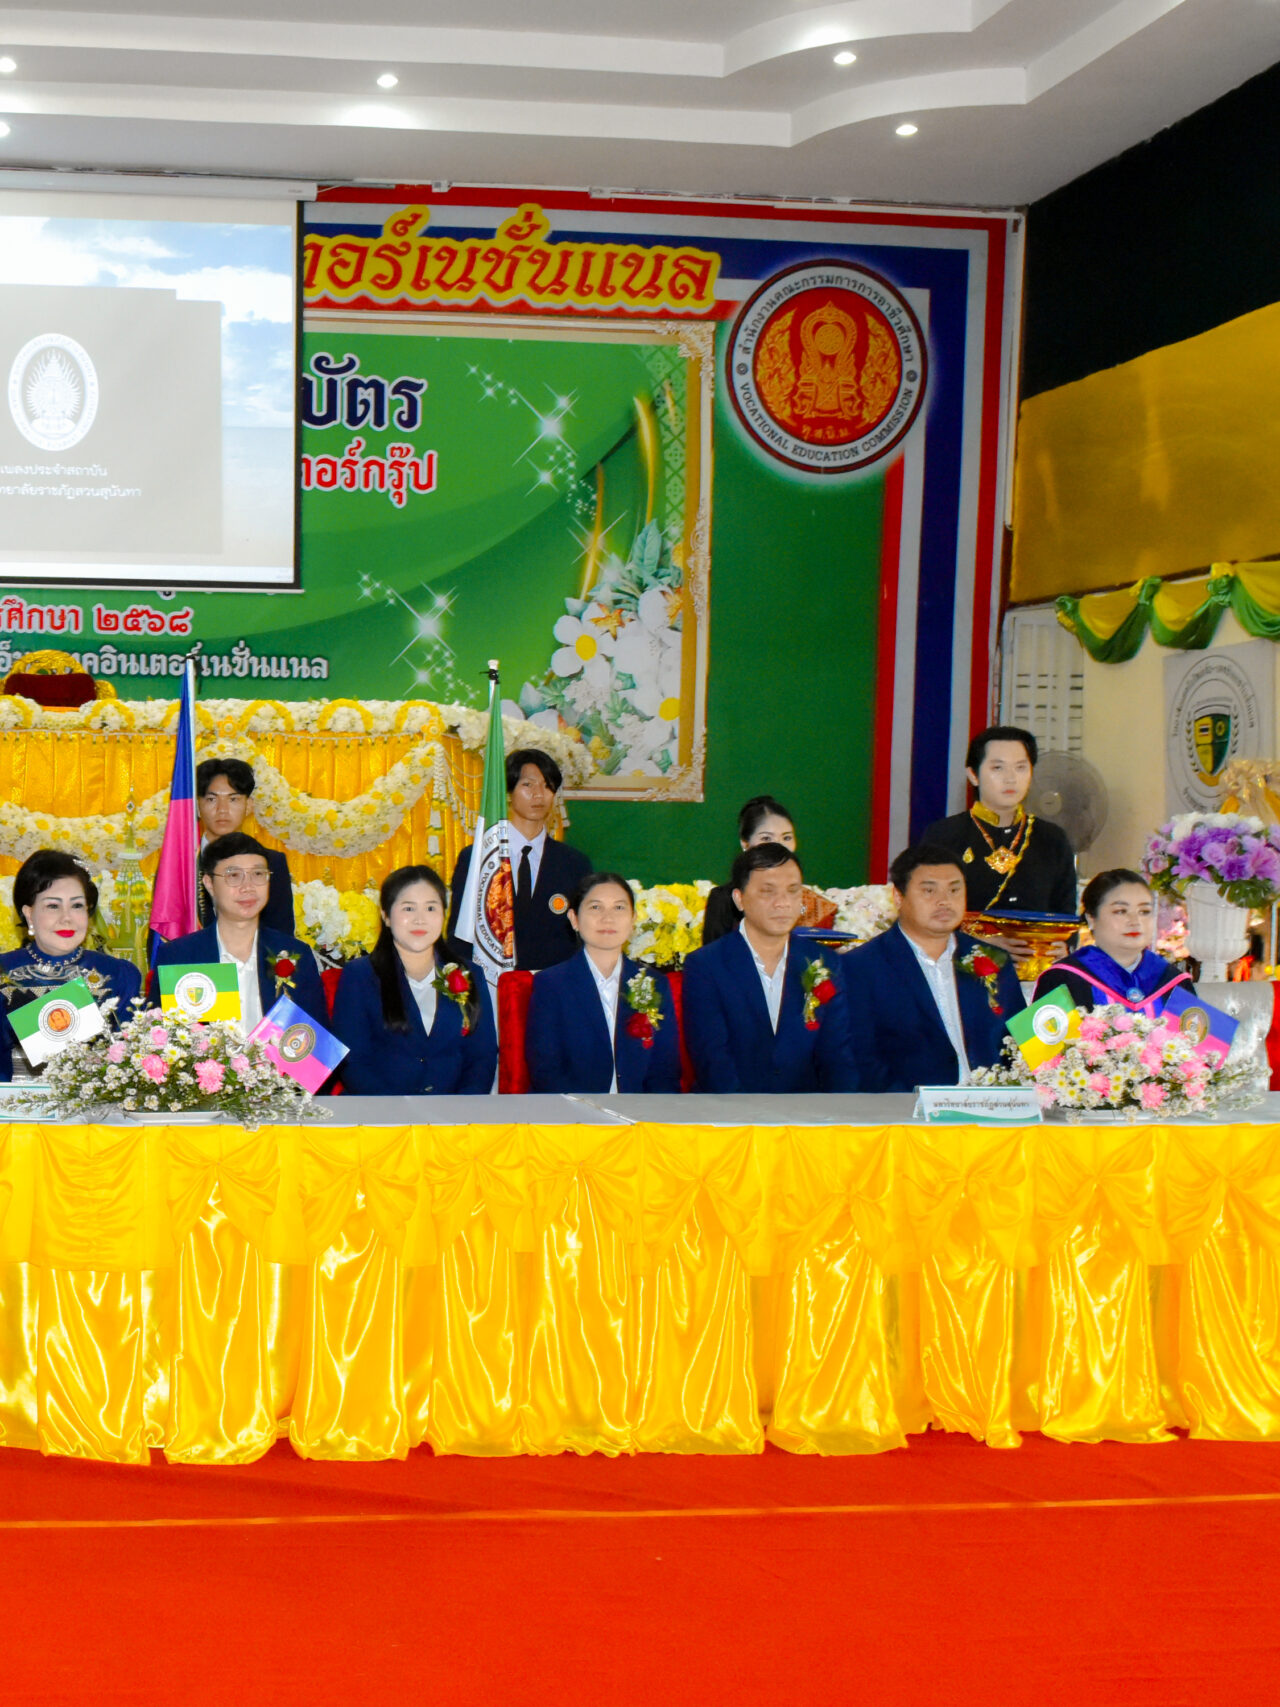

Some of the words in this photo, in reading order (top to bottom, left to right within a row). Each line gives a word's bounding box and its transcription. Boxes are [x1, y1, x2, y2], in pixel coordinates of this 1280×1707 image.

[740, 382, 789, 451] VOCATIONAL
[791, 443, 861, 463] EDUCATION
[861, 387, 914, 452] COMMISSION
[95, 605, 192, 634] ๒๕๖๘
